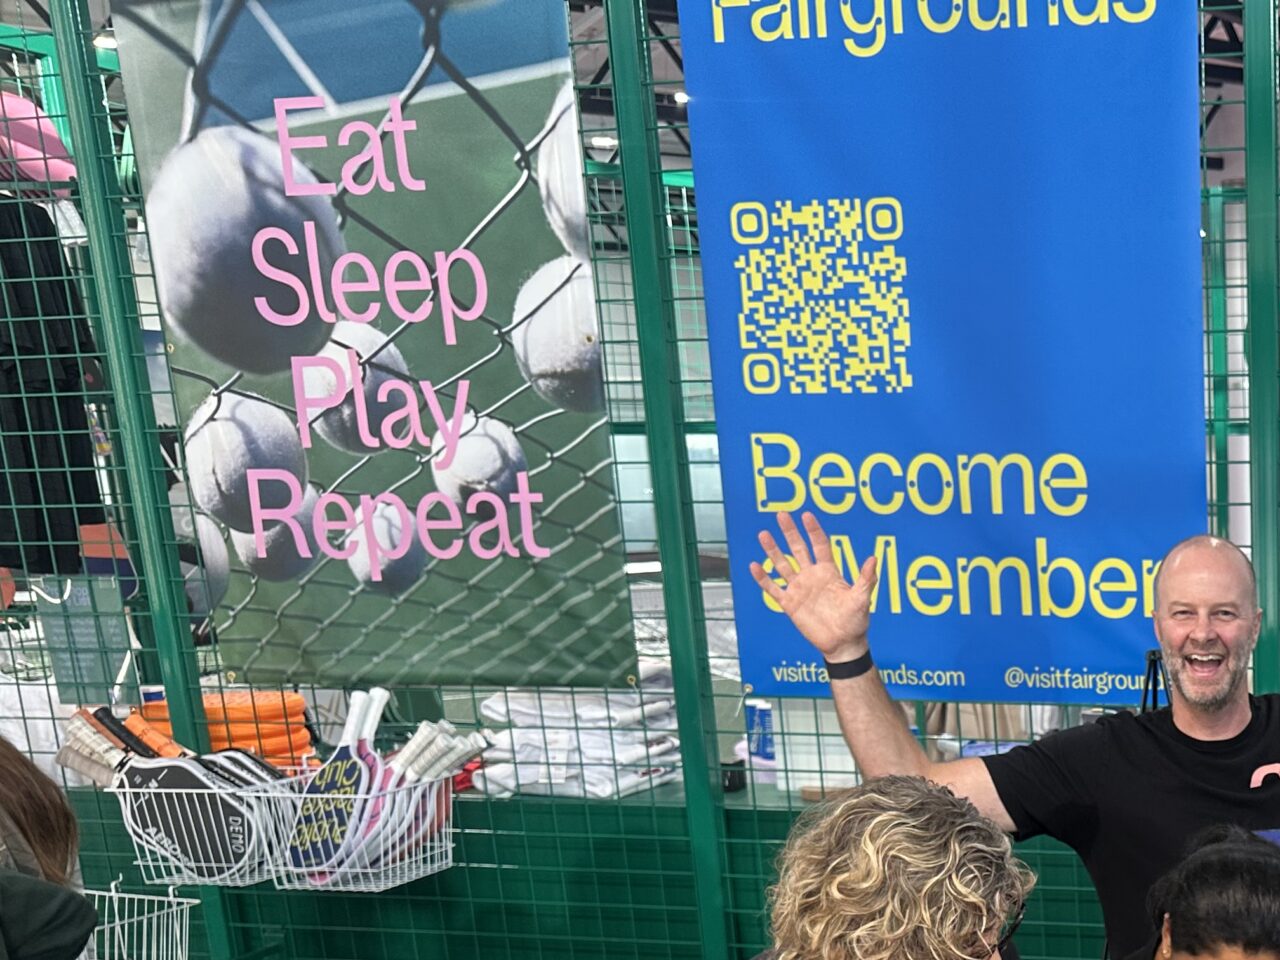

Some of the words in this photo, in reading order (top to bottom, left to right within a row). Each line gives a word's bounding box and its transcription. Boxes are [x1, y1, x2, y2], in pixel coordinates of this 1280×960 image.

[272, 97, 425, 197] Eat
[251, 221, 488, 346] Sleep
[289, 347, 471, 471] Play
[750, 432, 1088, 516] Become
[247, 468, 551, 582] Repeat
[829, 536, 1162, 619] Member
[1005, 665, 1173, 695] @visitfairground
[228, 814, 246, 854] DEMO
